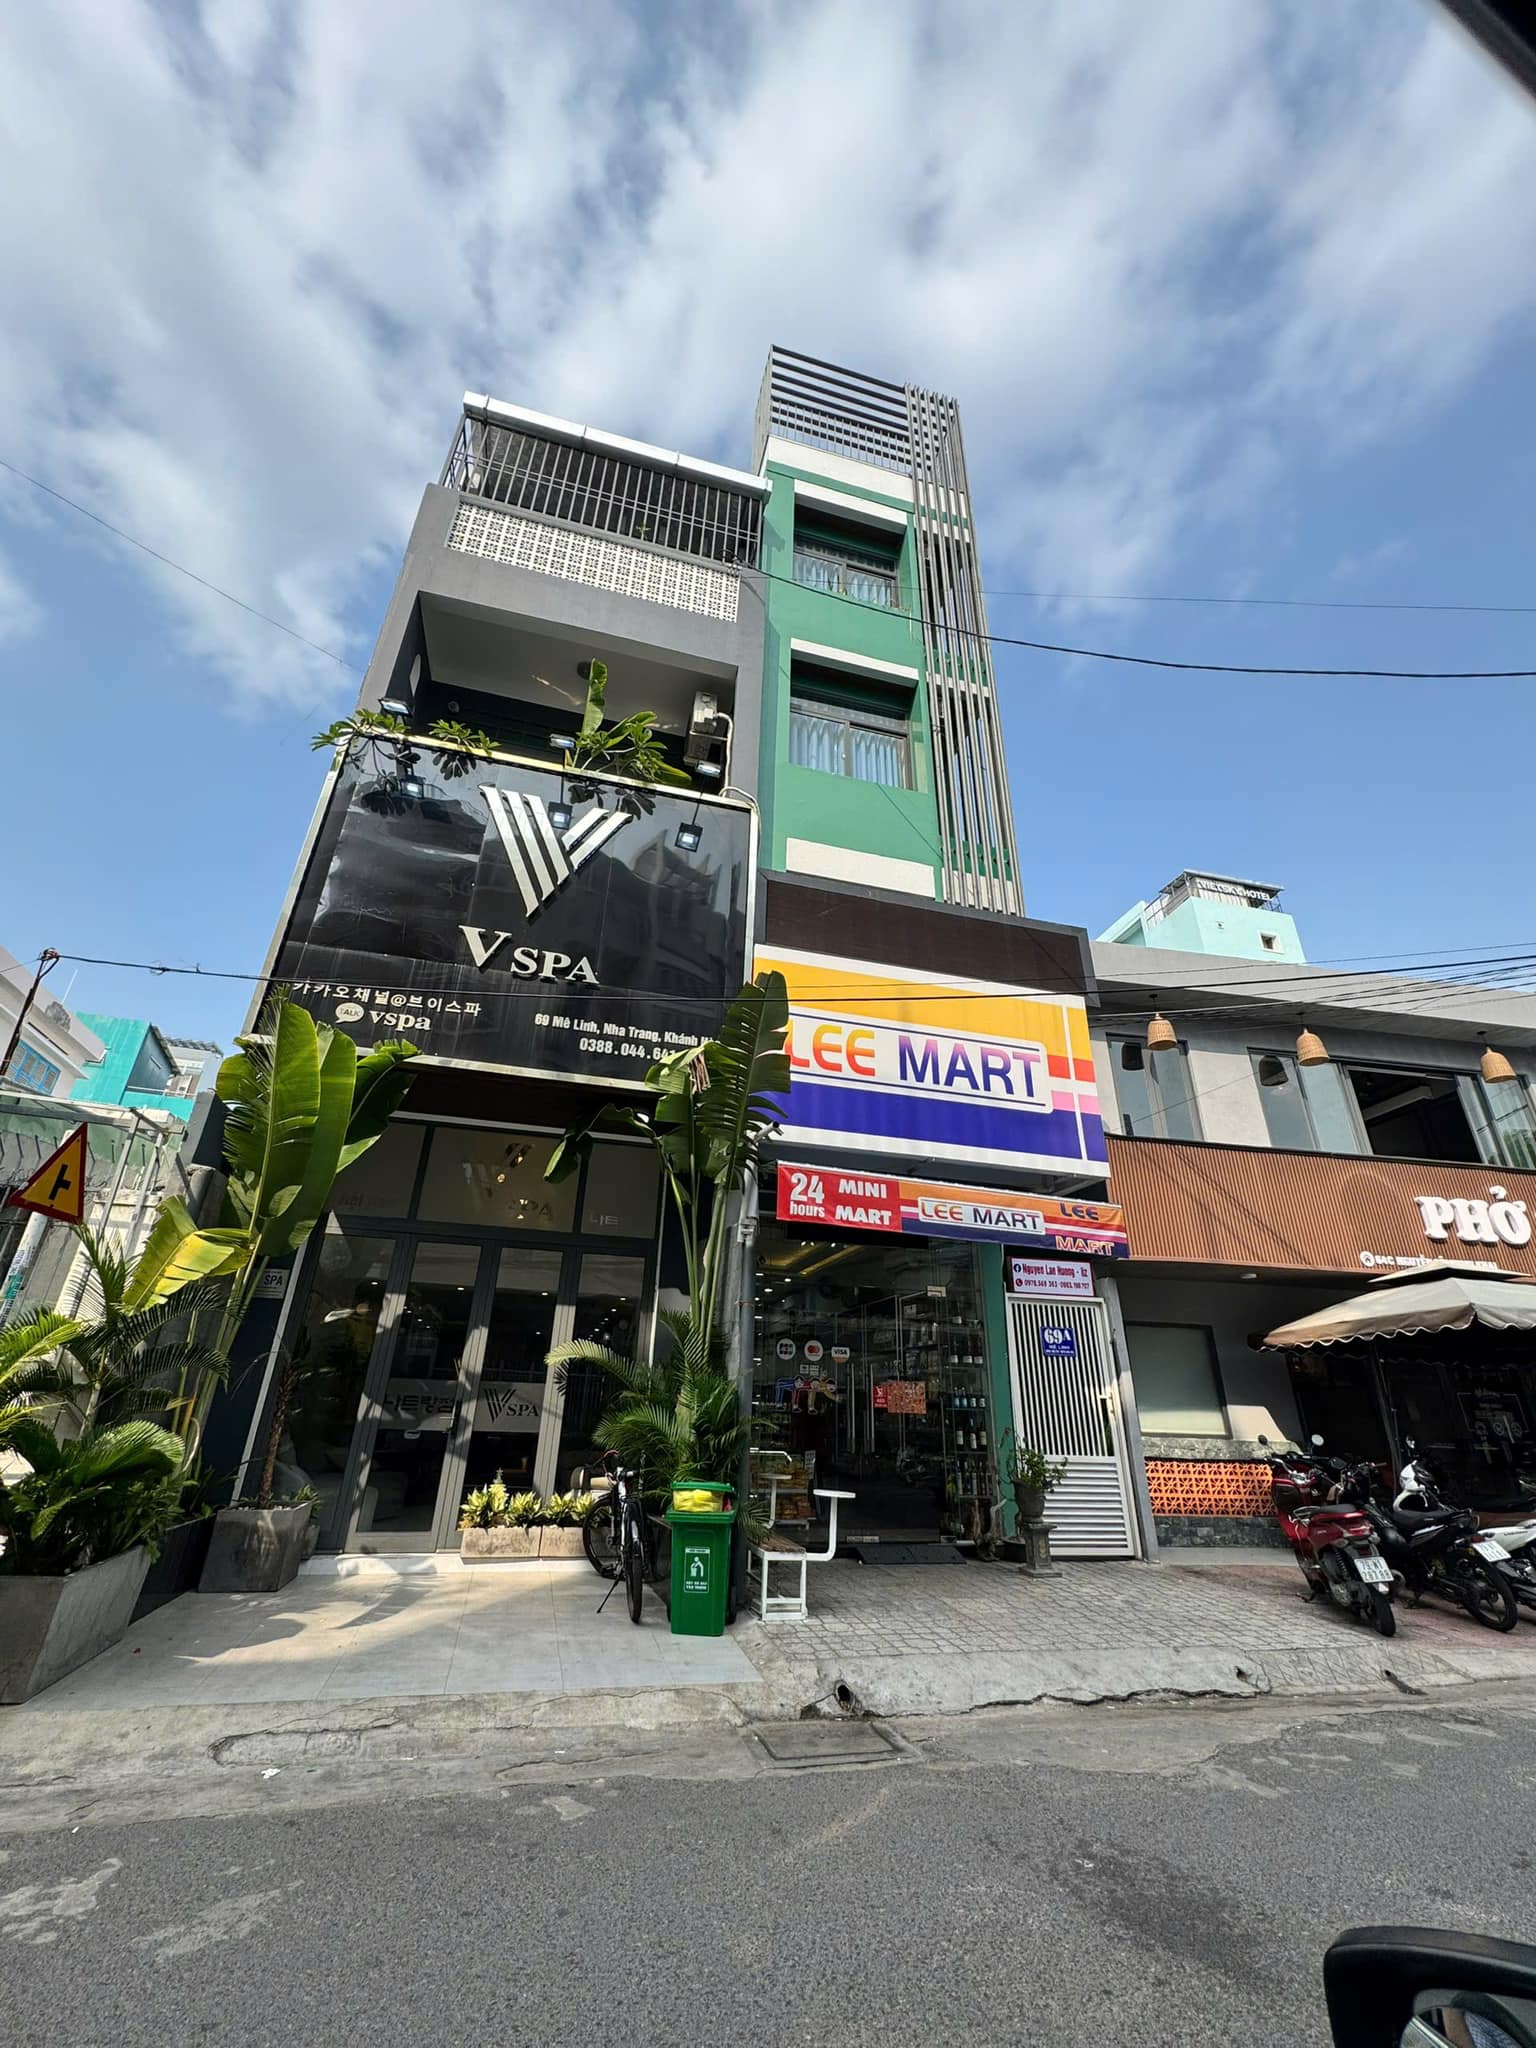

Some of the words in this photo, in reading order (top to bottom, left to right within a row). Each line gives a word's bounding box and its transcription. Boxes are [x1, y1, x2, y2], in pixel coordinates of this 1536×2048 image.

[459, 925, 512, 968] V
[511, 947, 600, 984] SPA
[369, 1010, 432, 1031] vspa
[535, 1013, 550, 1026] 69
[552, 1015, 571, 1029] Mê
[573, 1018, 600, 1034] Linh,
[603, 1023, 626, 1037] Nha
[628, 1026, 662, 1043] Trang,
[664, 1031, 699, 1046] Khánh
[785, 1020, 875, 1076] LEE
[898, 1035, 1041, 1098] MART
[790, 1172, 825, 1204] 24
[839, 1179, 887, 1199] MINI
[789, 1201, 825, 1218] hours
[835, 1205, 892, 1226] MART
[921, 1202, 963, 1221] LEE
[973, 1207, 1040, 1230] MART
[1060, 1203, 1099, 1220] LEE
[1414, 1185, 1532, 1245] PHỞ
[1055, 1235, 1115, 1256] MART
[1044, 1329, 1071, 1344] 69A
[506, 1403, 539, 1417] SPA
